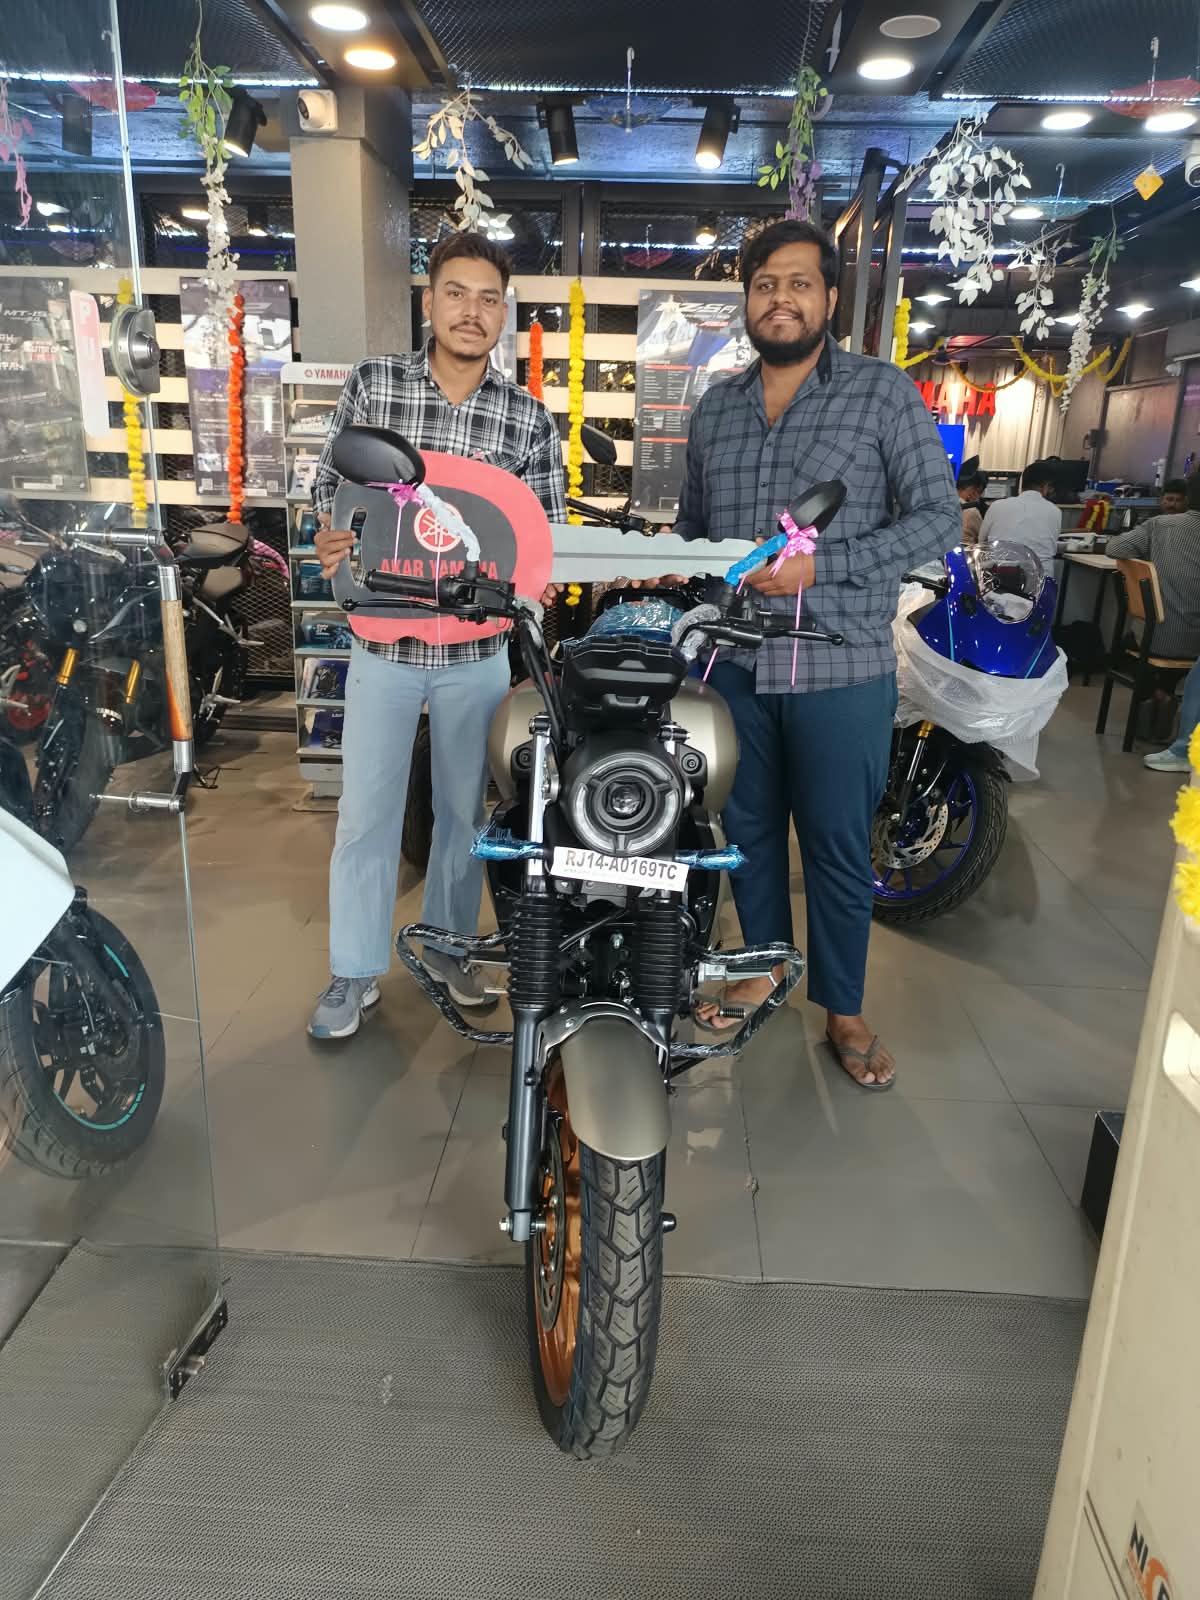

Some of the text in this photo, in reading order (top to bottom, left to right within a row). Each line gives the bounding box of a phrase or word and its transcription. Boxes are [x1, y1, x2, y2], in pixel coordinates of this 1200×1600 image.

[914, 381, 996, 416] MAHA
[381, 559, 498, 580] AKAR YAMHA
